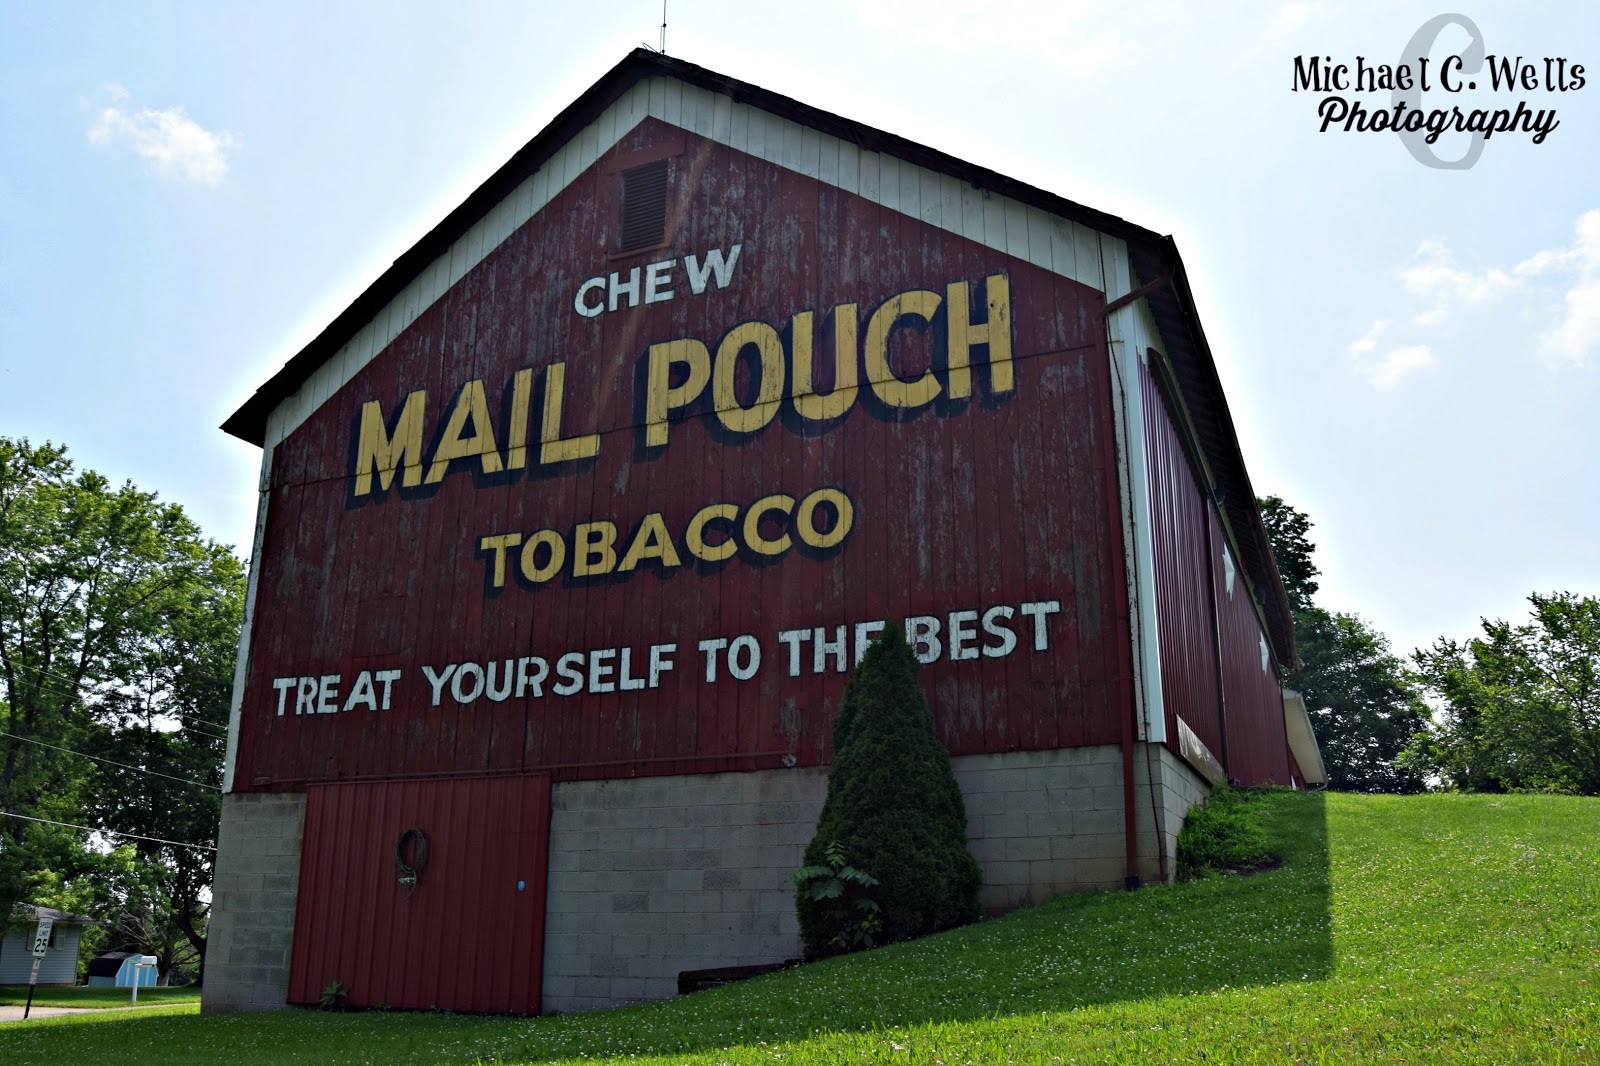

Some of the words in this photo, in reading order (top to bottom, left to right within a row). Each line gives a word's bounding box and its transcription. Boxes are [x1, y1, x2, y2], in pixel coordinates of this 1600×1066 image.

[574, 243, 742, 318] CHEW
[353, 361, 601, 497] MAIL
[645, 272, 1014, 448] POUCH
[480, 487, 854, 588] TOBACCO
[272, 669, 402, 716] TREAT
[421, 643, 677, 706] YOURSELF
[698, 634, 762, 683] TO
[904, 600, 1061, 665] BEST
[34, 938, 48, 953] 25
[39, 921, 52, 929] SPEED
